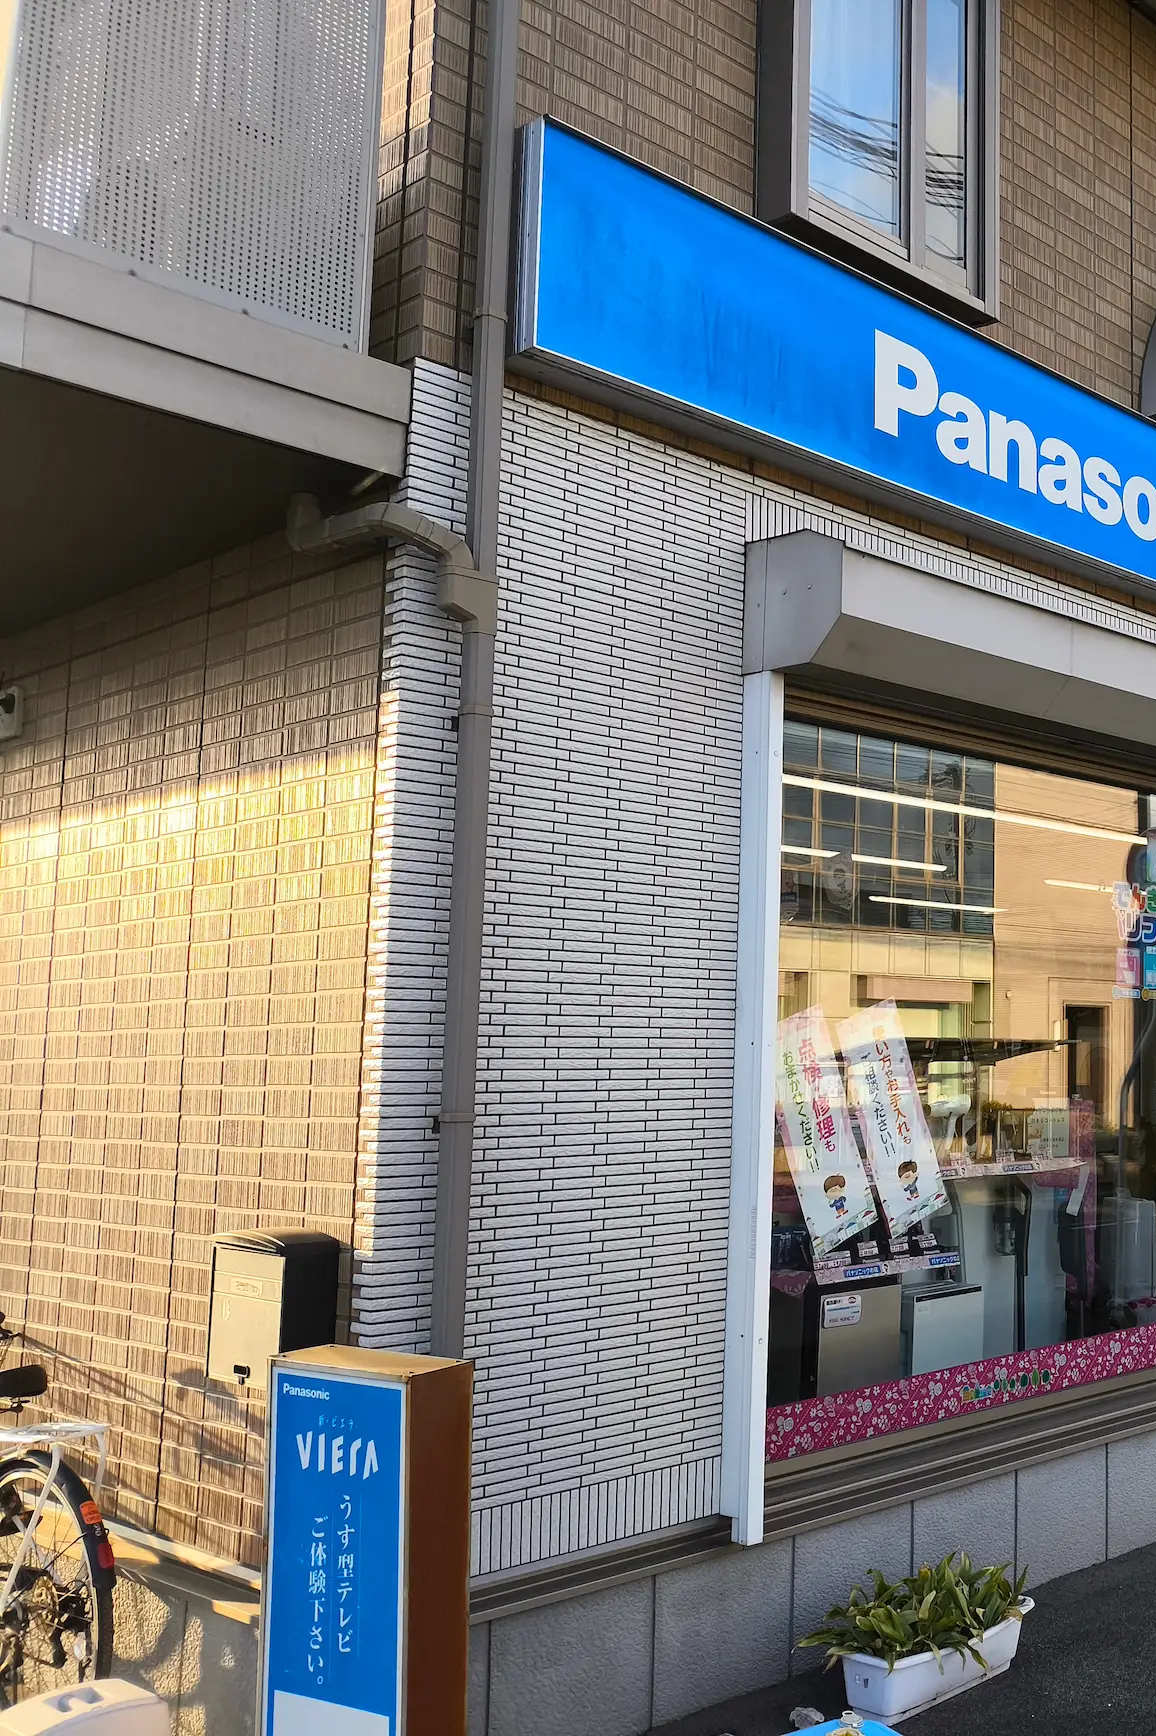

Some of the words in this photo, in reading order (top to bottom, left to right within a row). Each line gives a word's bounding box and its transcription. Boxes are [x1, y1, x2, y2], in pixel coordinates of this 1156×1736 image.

[283, 1383, 330, 1401] Panasonic
[295, 1430, 379, 1481] VIERA
[306, 1515, 328, 1685] ご体験下さい。
[336, 1494, 356, 1655] うす型テレビ
